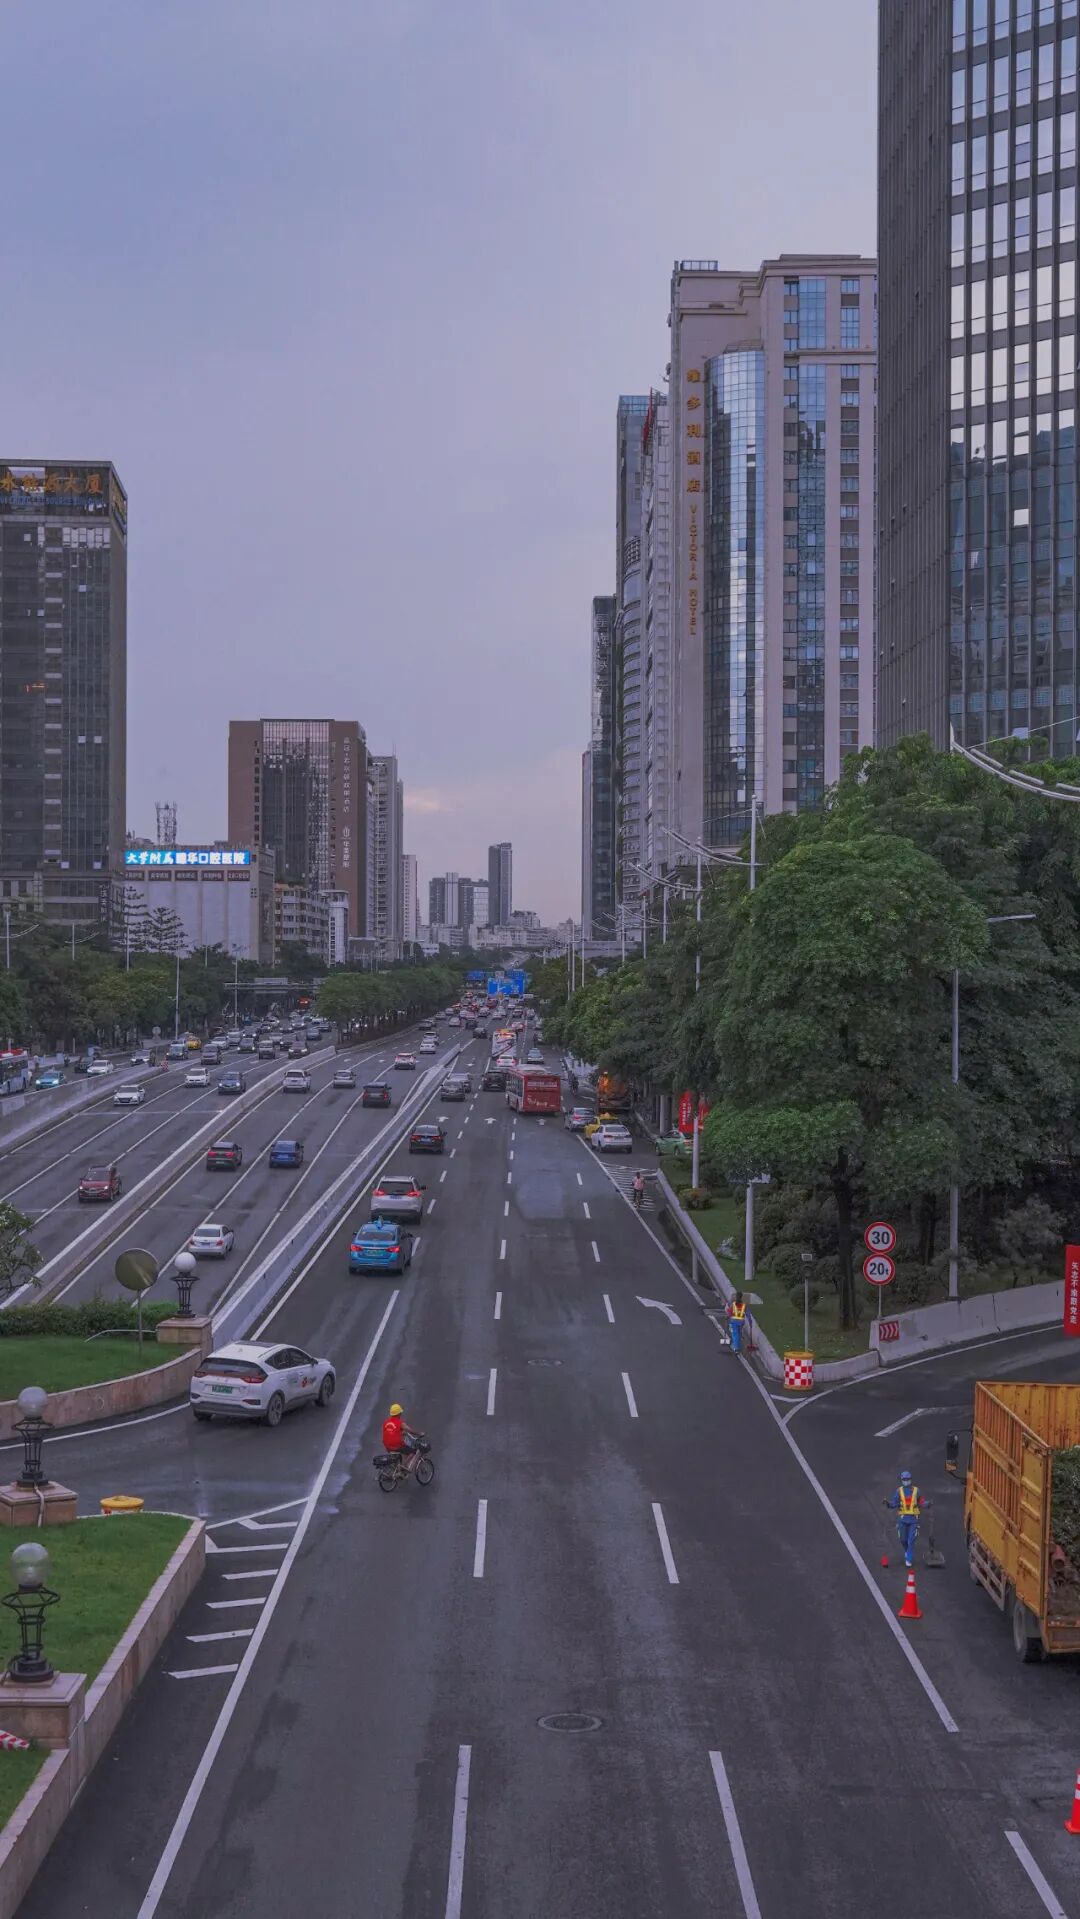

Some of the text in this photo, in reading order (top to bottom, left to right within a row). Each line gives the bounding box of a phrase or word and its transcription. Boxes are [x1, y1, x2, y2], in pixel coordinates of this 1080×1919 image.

[688, 504, 699, 636] VICTORIA HOTEL
[871, 1231, 890, 1245] 30
